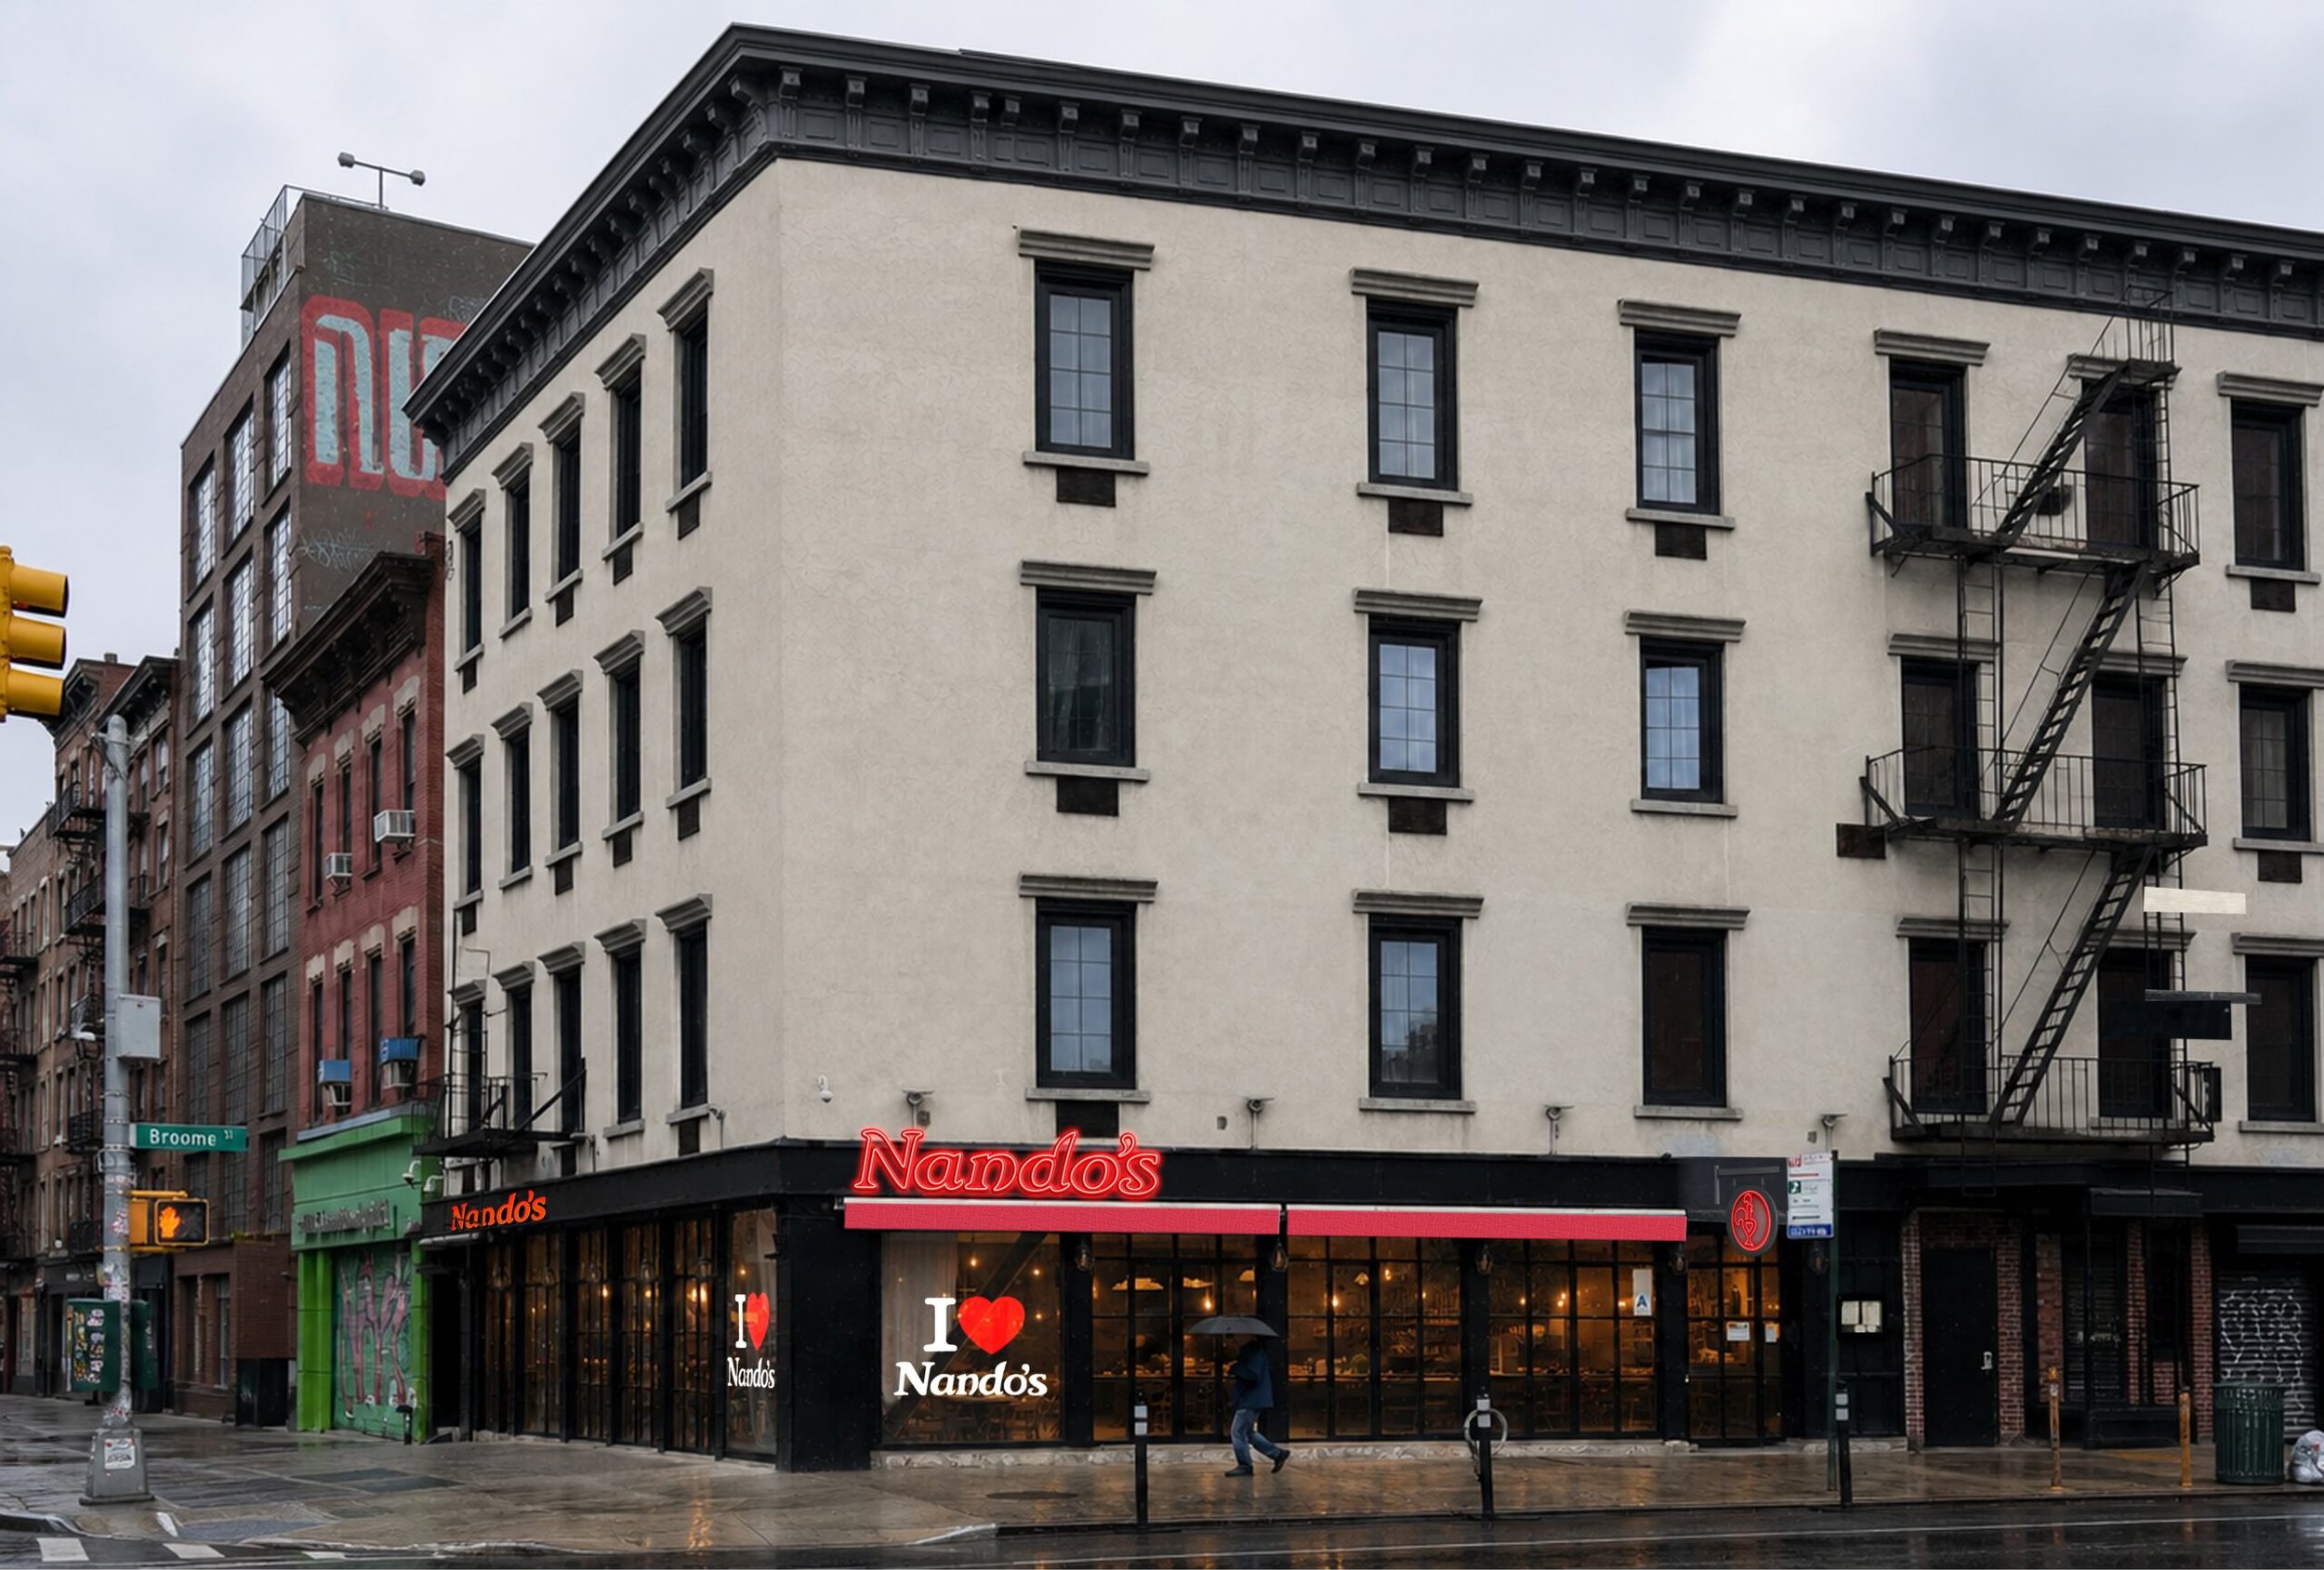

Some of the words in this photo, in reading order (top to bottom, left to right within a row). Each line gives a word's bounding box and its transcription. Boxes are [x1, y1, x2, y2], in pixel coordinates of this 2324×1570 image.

[150, 1128, 217, 1147] Broome
[852, 1128, 1160, 1196] Nando's
[450, 1189, 548, 1232] Nando's
[734, 1293, 747, 1349] I
[923, 1297, 958, 1352] I
[727, 1356, 775, 1389] Nando's
[893, 1360, 1049, 1396] Nando's
